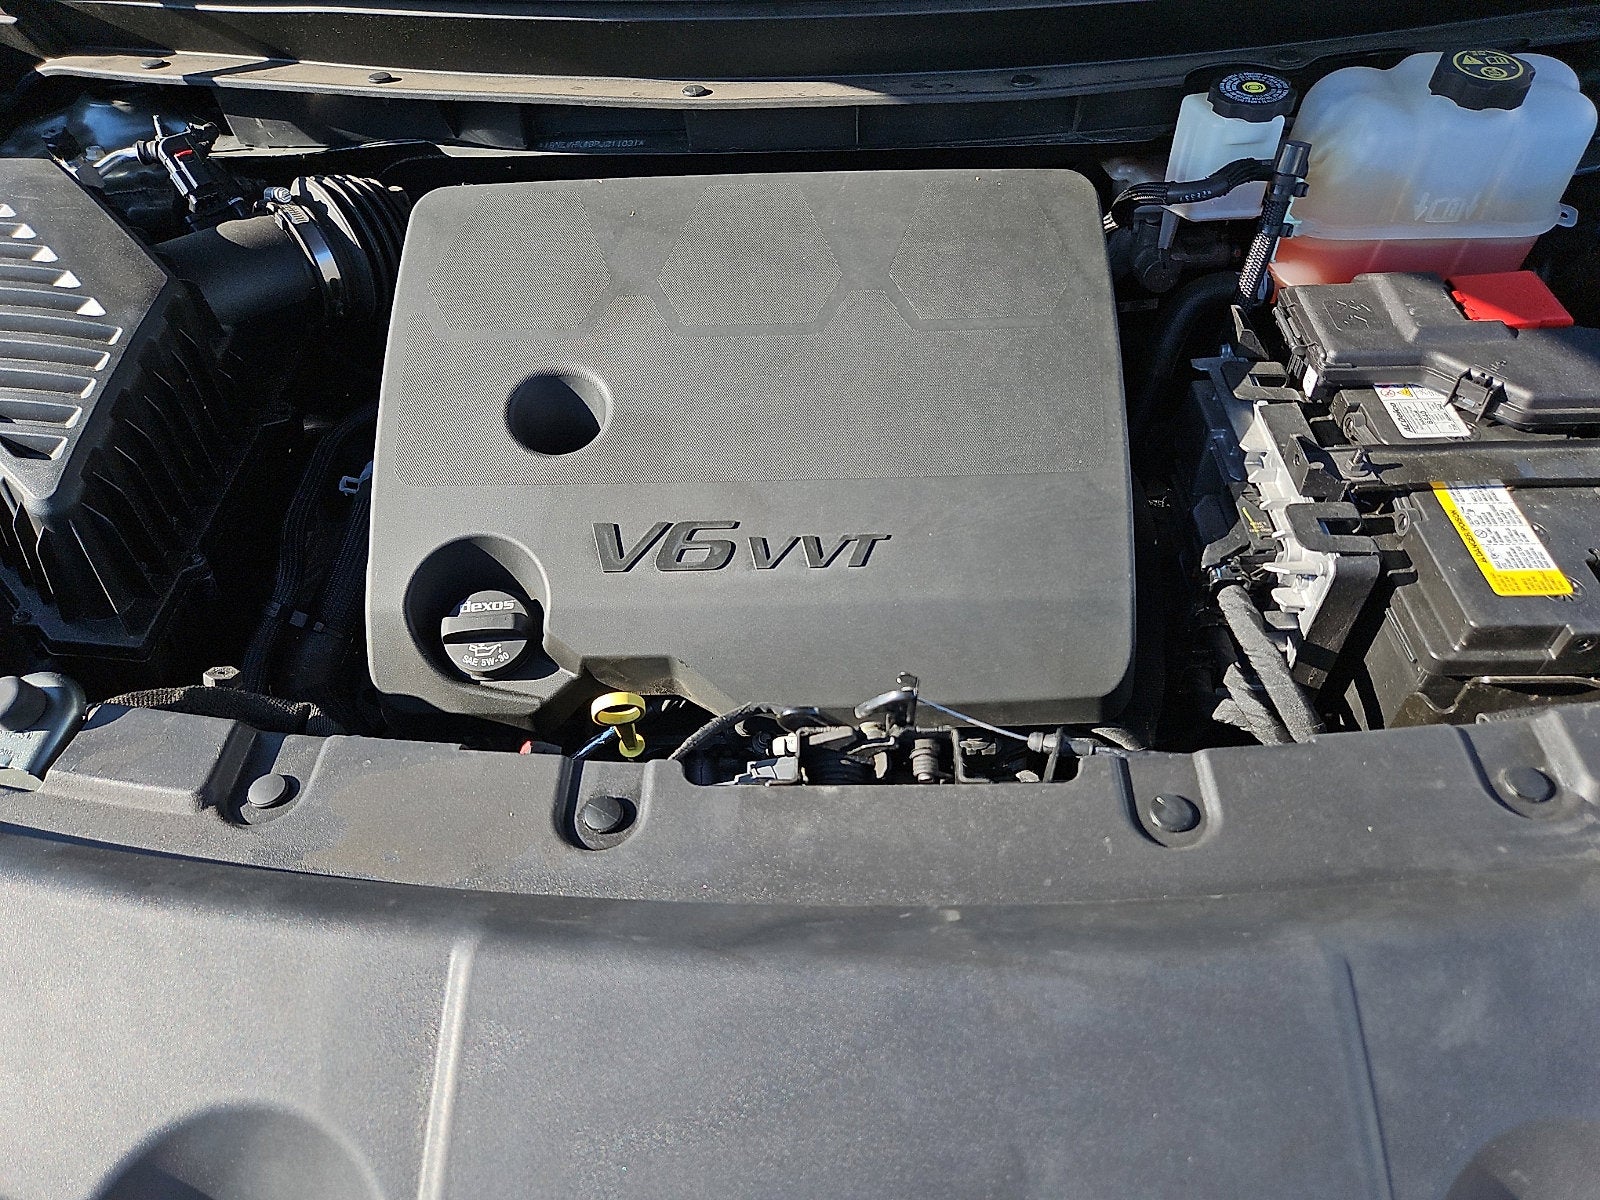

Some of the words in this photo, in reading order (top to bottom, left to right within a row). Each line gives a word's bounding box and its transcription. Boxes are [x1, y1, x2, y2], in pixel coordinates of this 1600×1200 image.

[592, 520, 740, 573] V6
[748, 534, 892, 570] VVT
[460, 600, 516, 612] dexos
[462, 655, 479, 667] SAE
[480, 652, 510, 667] 5W-30
